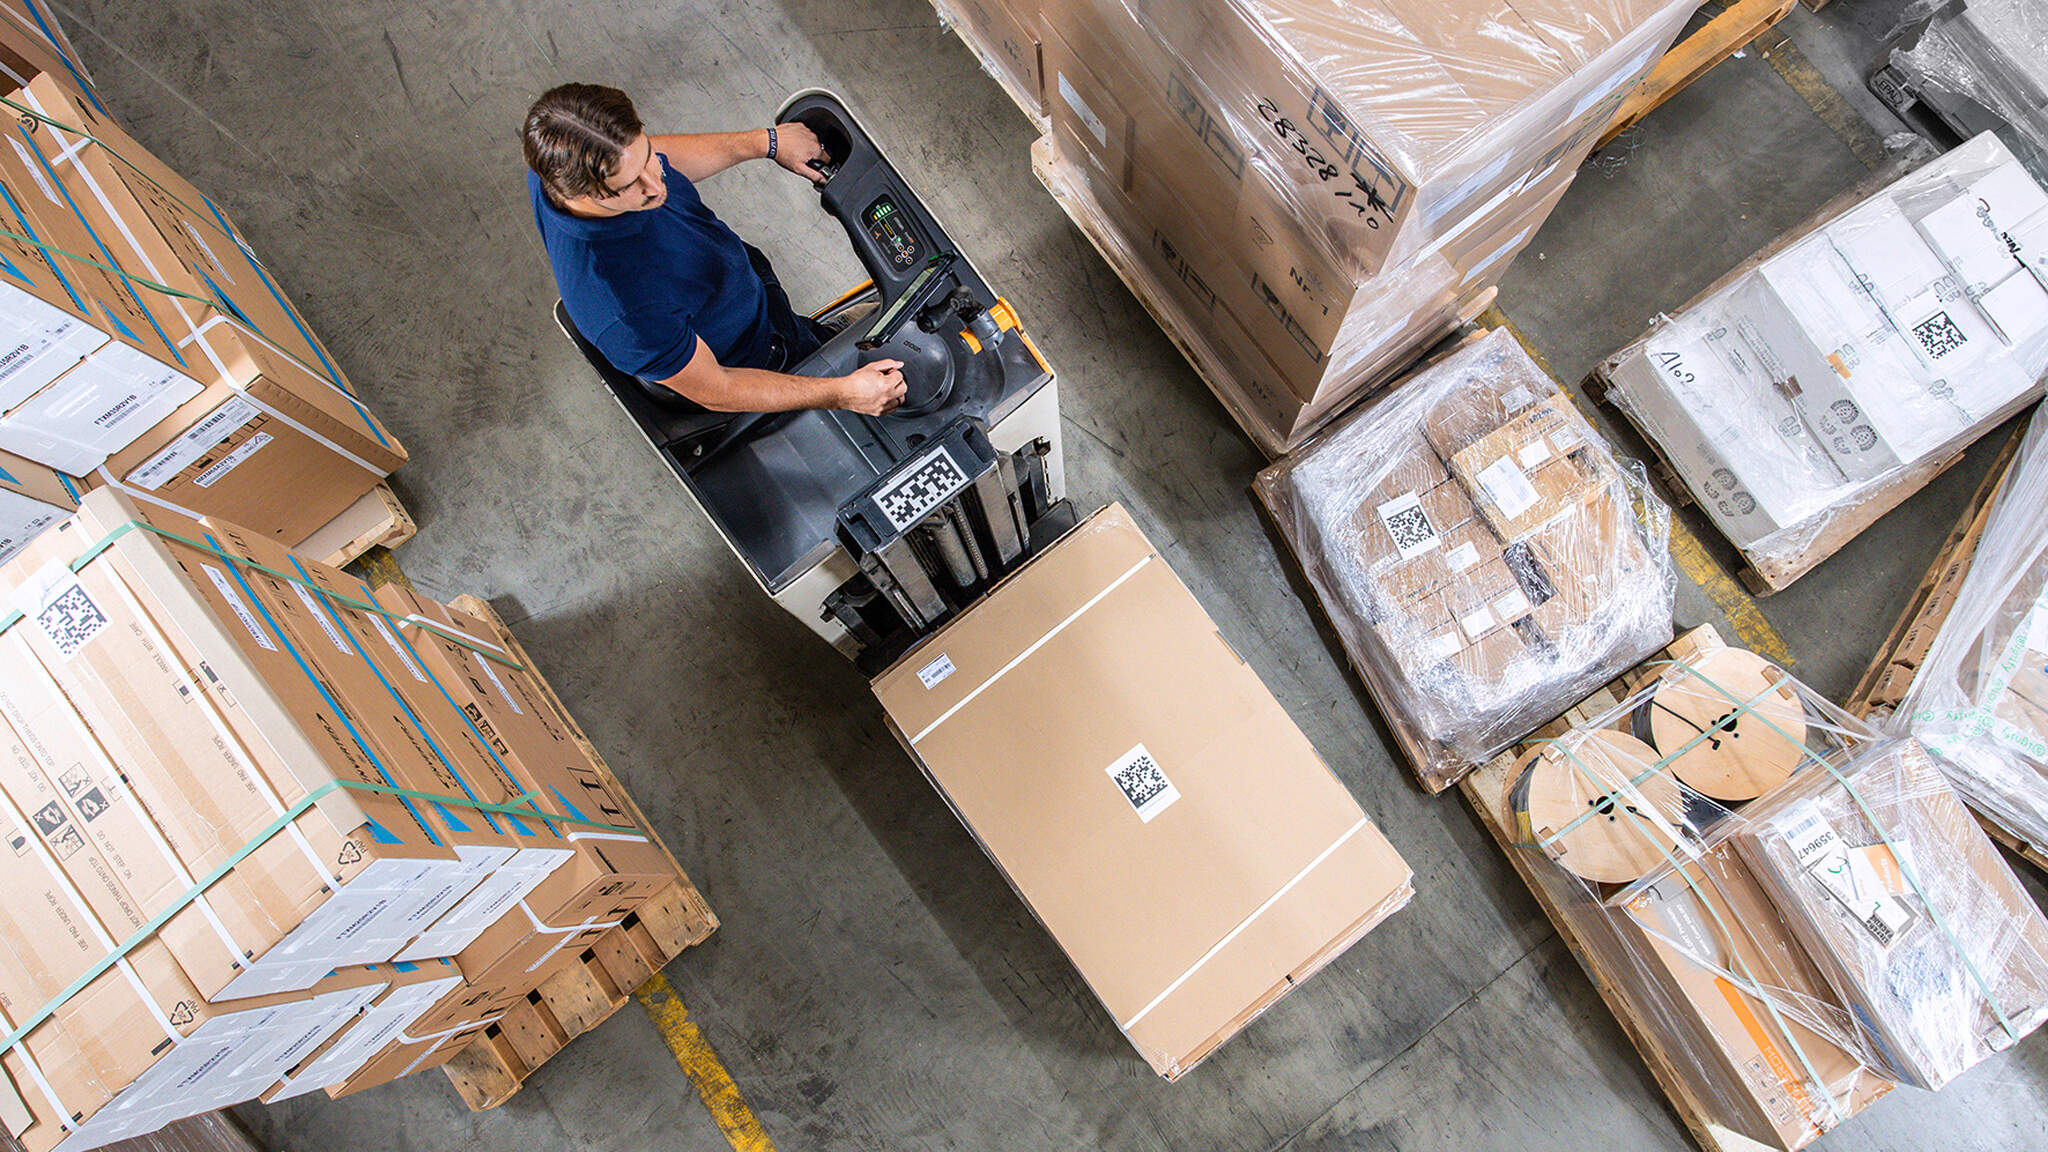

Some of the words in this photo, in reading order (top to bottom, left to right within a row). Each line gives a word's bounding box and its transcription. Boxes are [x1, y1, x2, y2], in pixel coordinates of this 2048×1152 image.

[1877, 80, 1900, 101] EPAL
[1257, 97, 1339, 182] 28328
[1798, 831, 1834, 860] 359647
